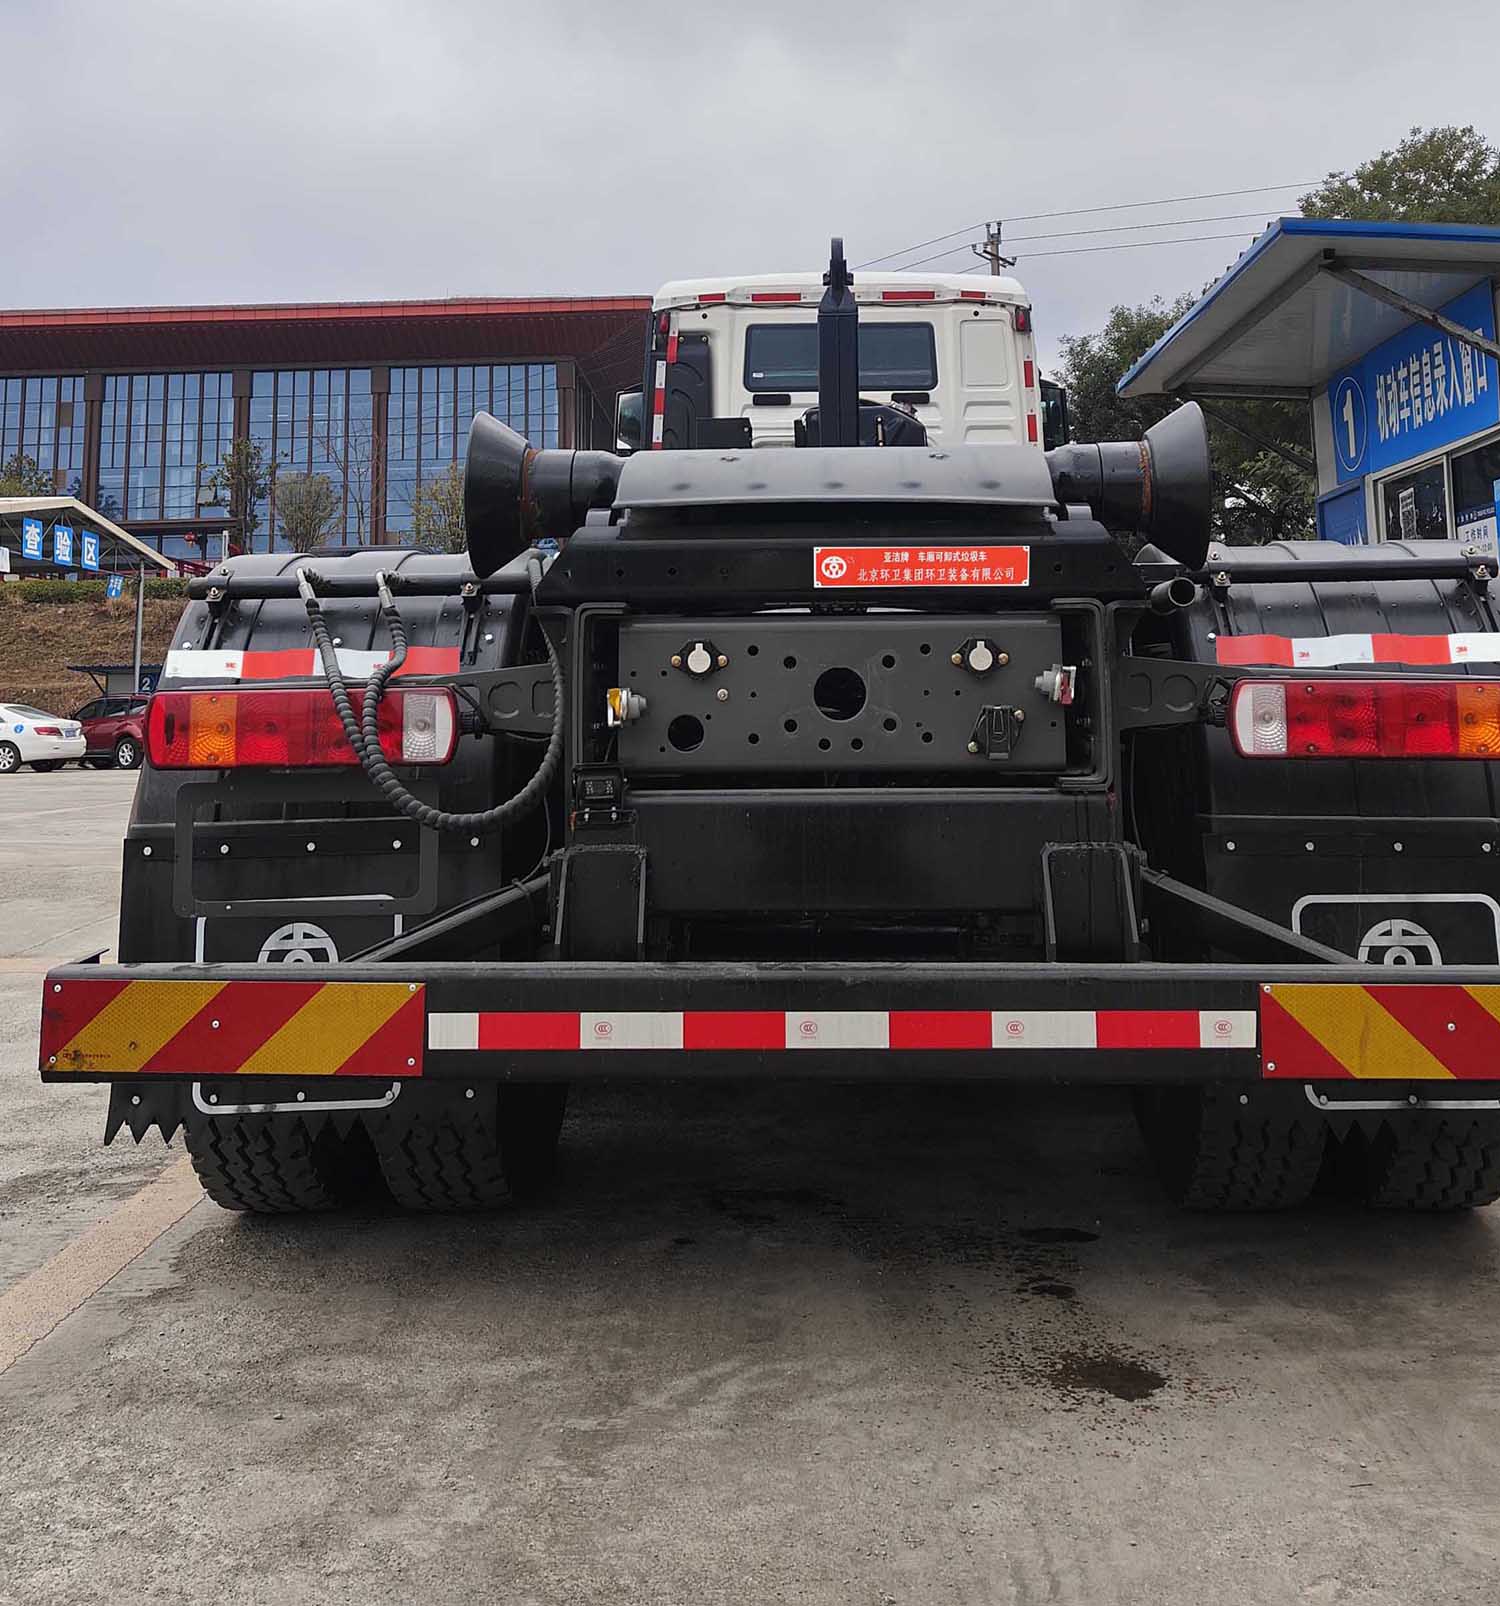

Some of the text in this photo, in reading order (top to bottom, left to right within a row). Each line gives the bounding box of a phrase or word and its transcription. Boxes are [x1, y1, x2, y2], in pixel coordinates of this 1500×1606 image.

[1376, 328, 1488, 443] 机动车信息录入窗口
[25, 523, 97, 567] 查验区
[918, 551, 988, 562] 车厢可卸式垃圾车
[857, 567, 1015, 582] 北京环卫集团环卫装备有限公司
[142, 677, 151, 691] 2
